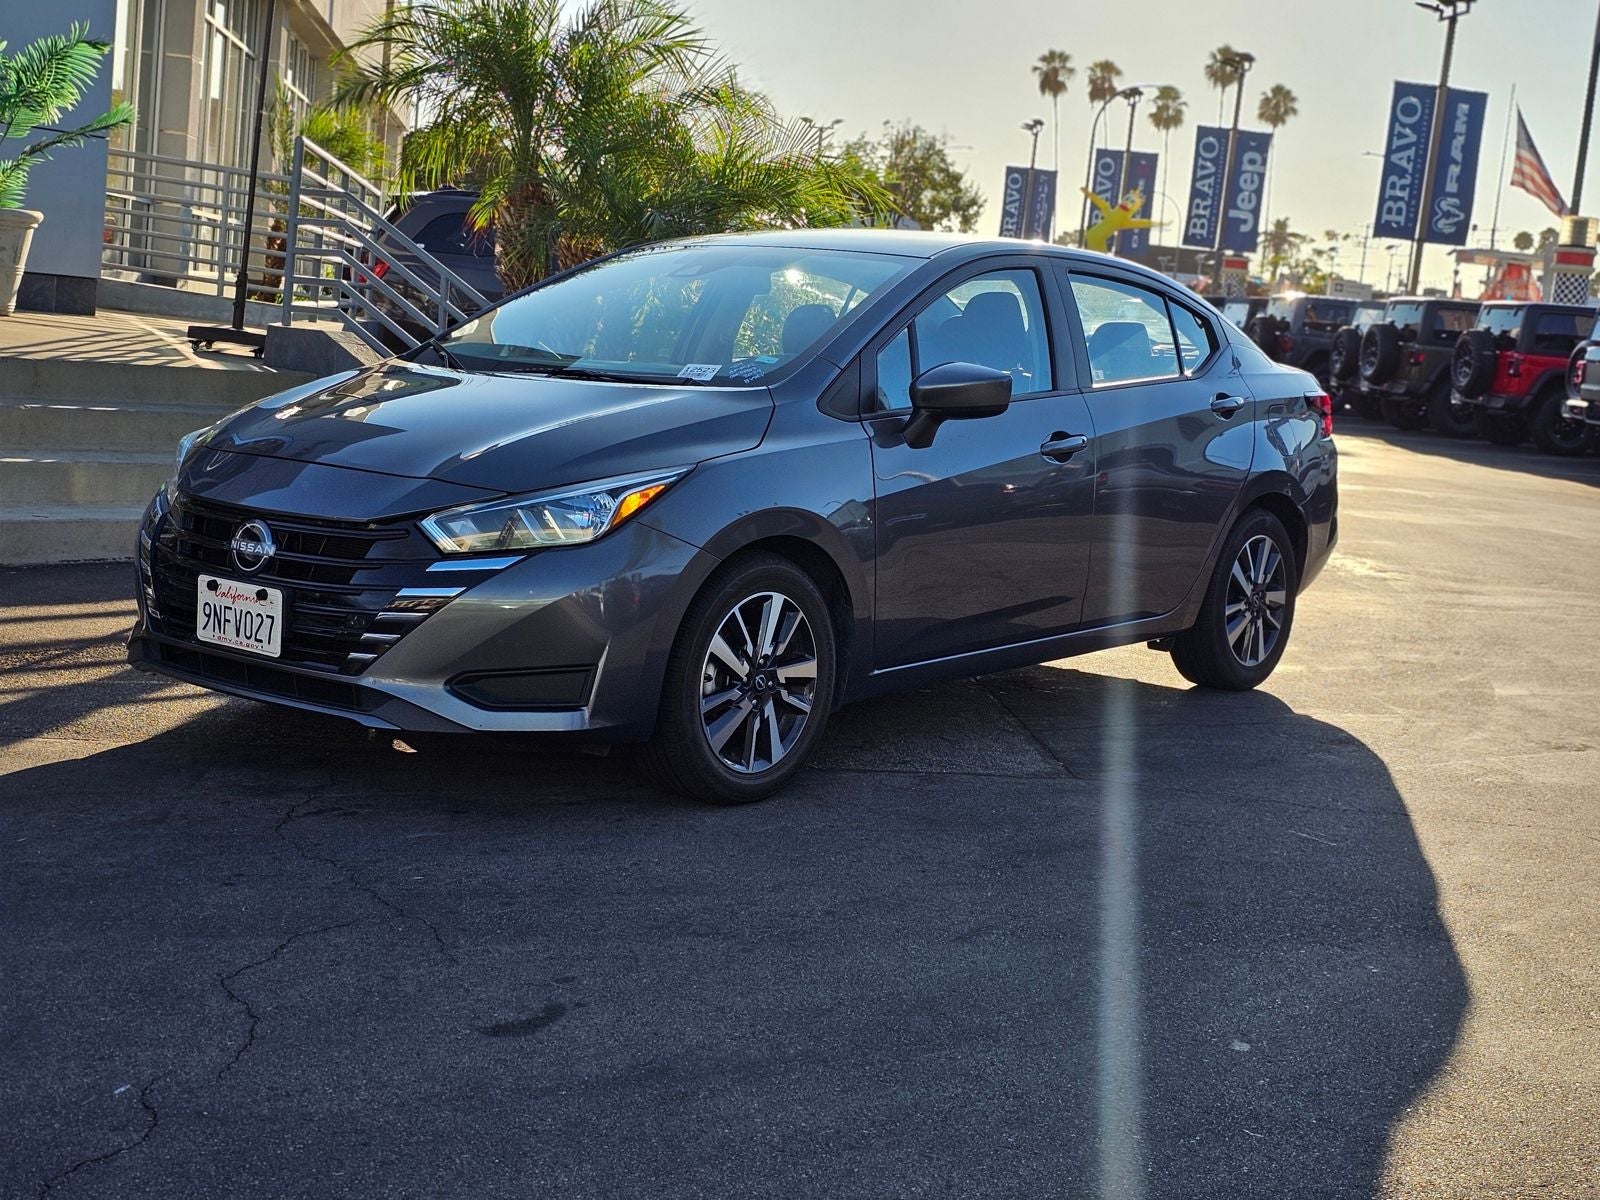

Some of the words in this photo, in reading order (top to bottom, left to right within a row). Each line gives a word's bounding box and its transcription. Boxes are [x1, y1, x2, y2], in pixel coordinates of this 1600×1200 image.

[1189, 136, 1219, 238] BRAVO
[1381, 96, 1422, 227] BRAVO
[1445, 102, 1470, 193] RAM
[1228, 151, 1265, 232] Jeep
[230, 539, 276, 557] NISSAN
[202, 602, 275, 645] 9NFV027
